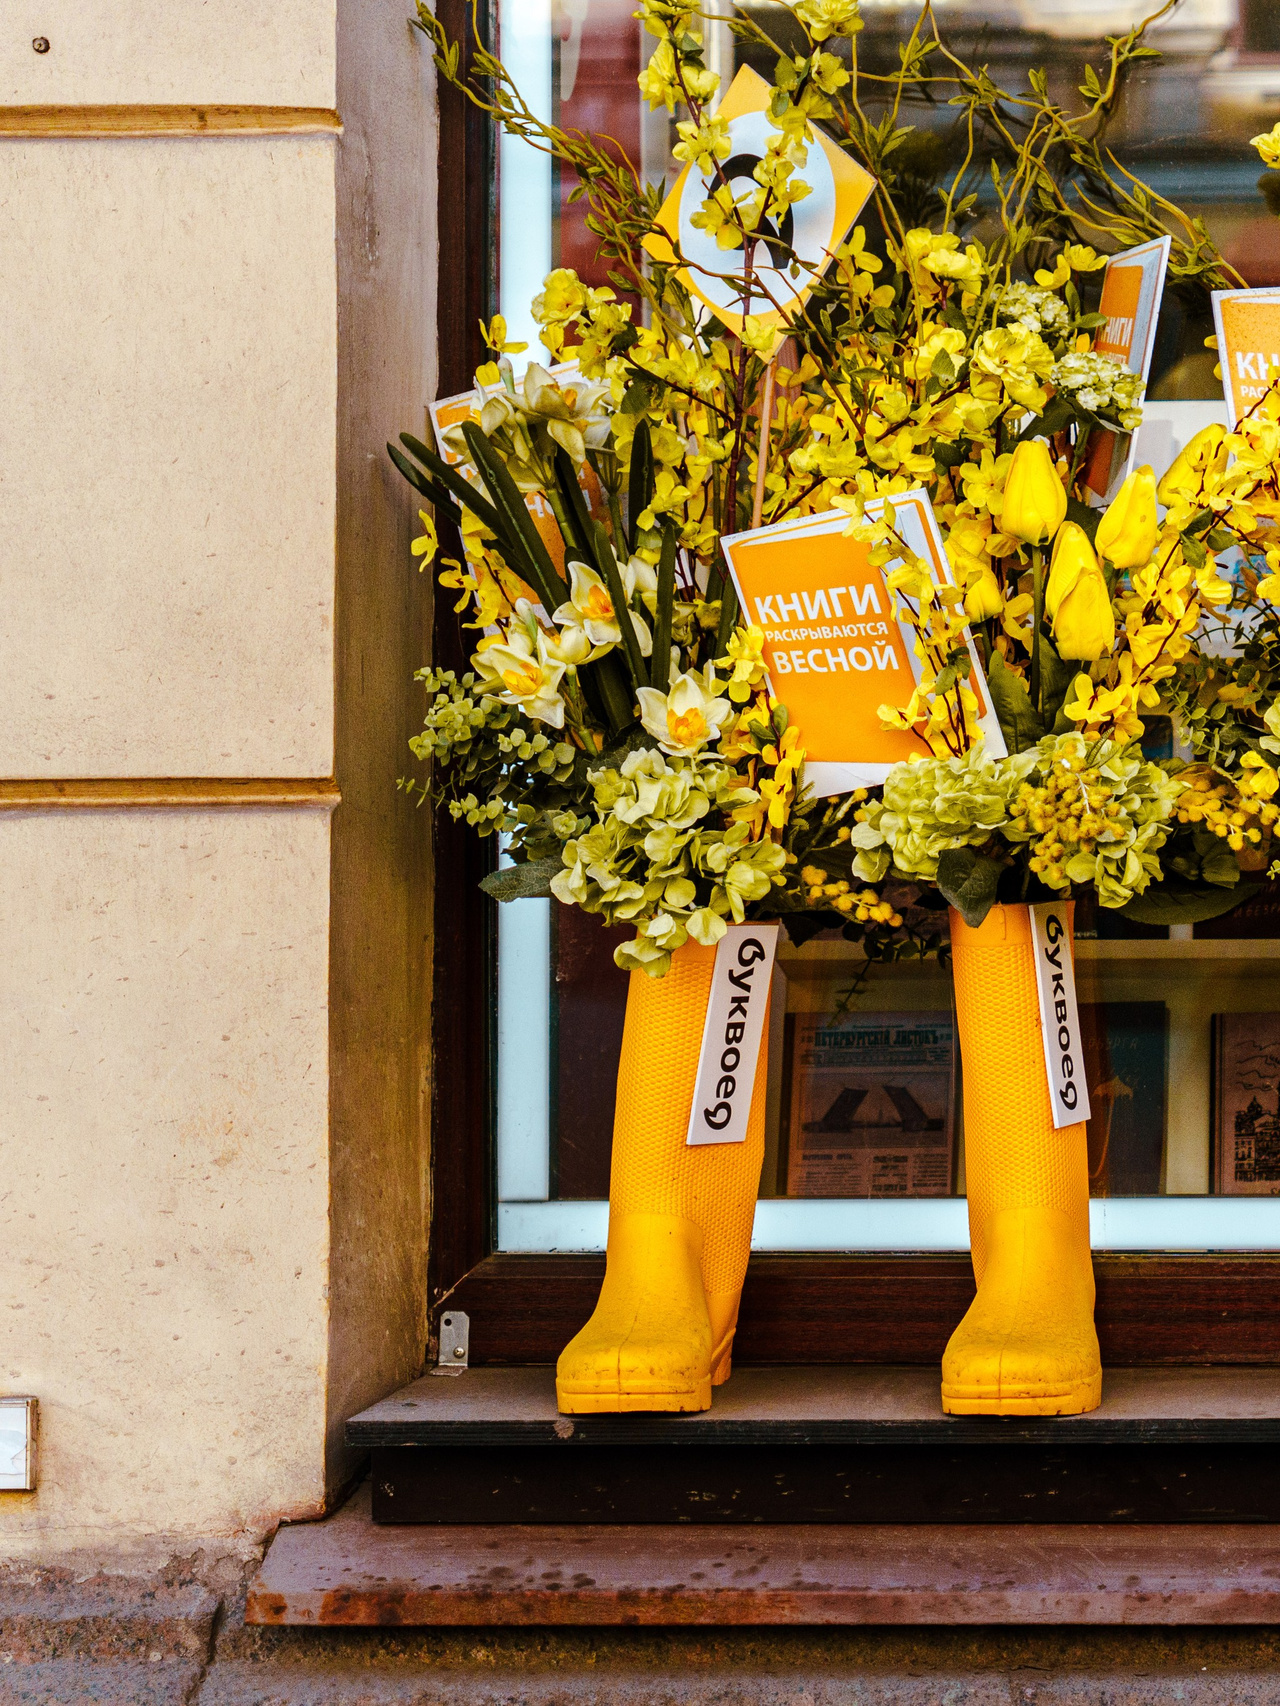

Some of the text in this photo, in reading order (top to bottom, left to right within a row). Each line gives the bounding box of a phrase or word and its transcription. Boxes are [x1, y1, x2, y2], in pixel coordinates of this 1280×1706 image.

[1101, 316, 1133, 347] НИГИ
[754, 583, 882, 624] КНИГИ
[765, 622, 888, 642] РАСКРЫВАЮТСЯ
[772, 640, 899, 674] ВЕСНОЙ
